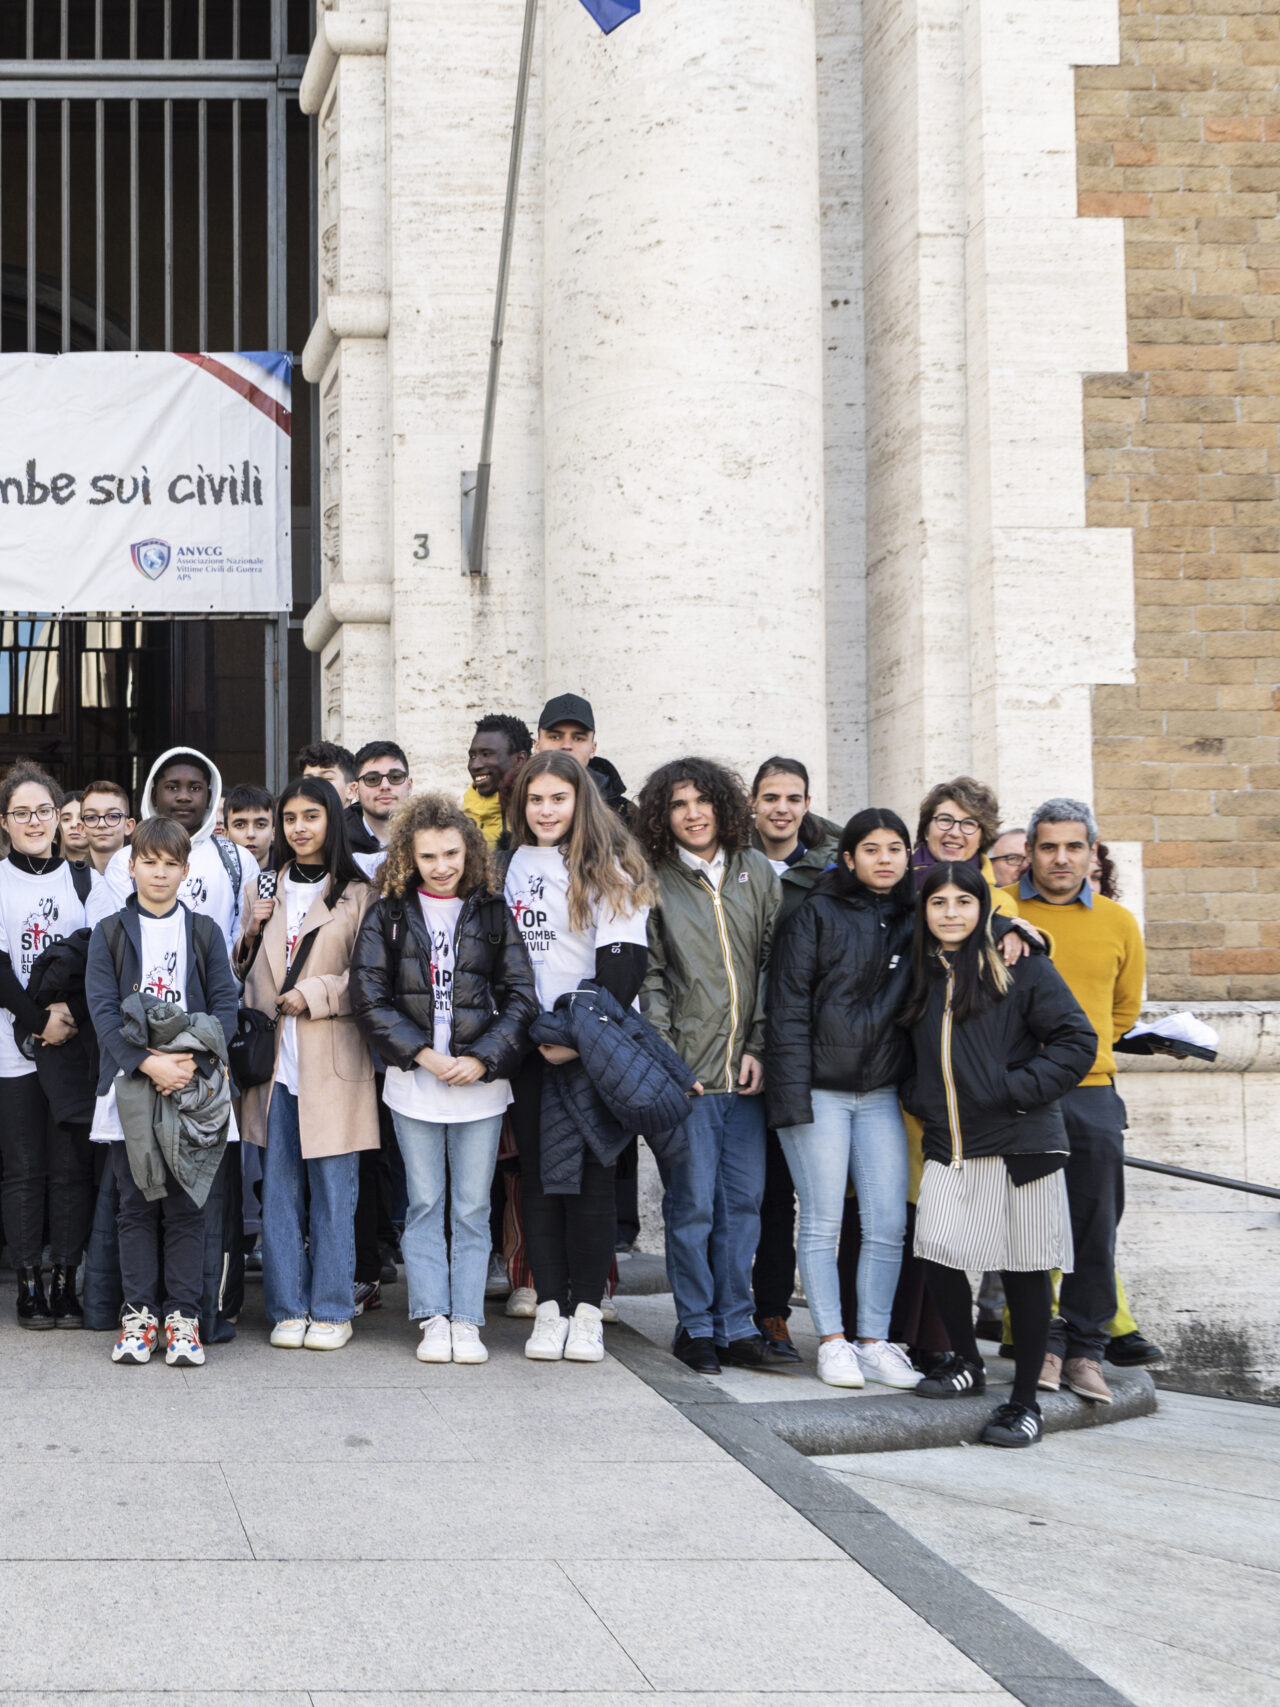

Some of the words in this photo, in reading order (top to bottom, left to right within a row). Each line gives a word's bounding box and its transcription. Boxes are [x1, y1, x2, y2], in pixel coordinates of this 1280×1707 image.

[177, 546, 222, 556] ANVCG
[413, 533, 429, 560] 3
[527, 942, 550, 951] IVILI
